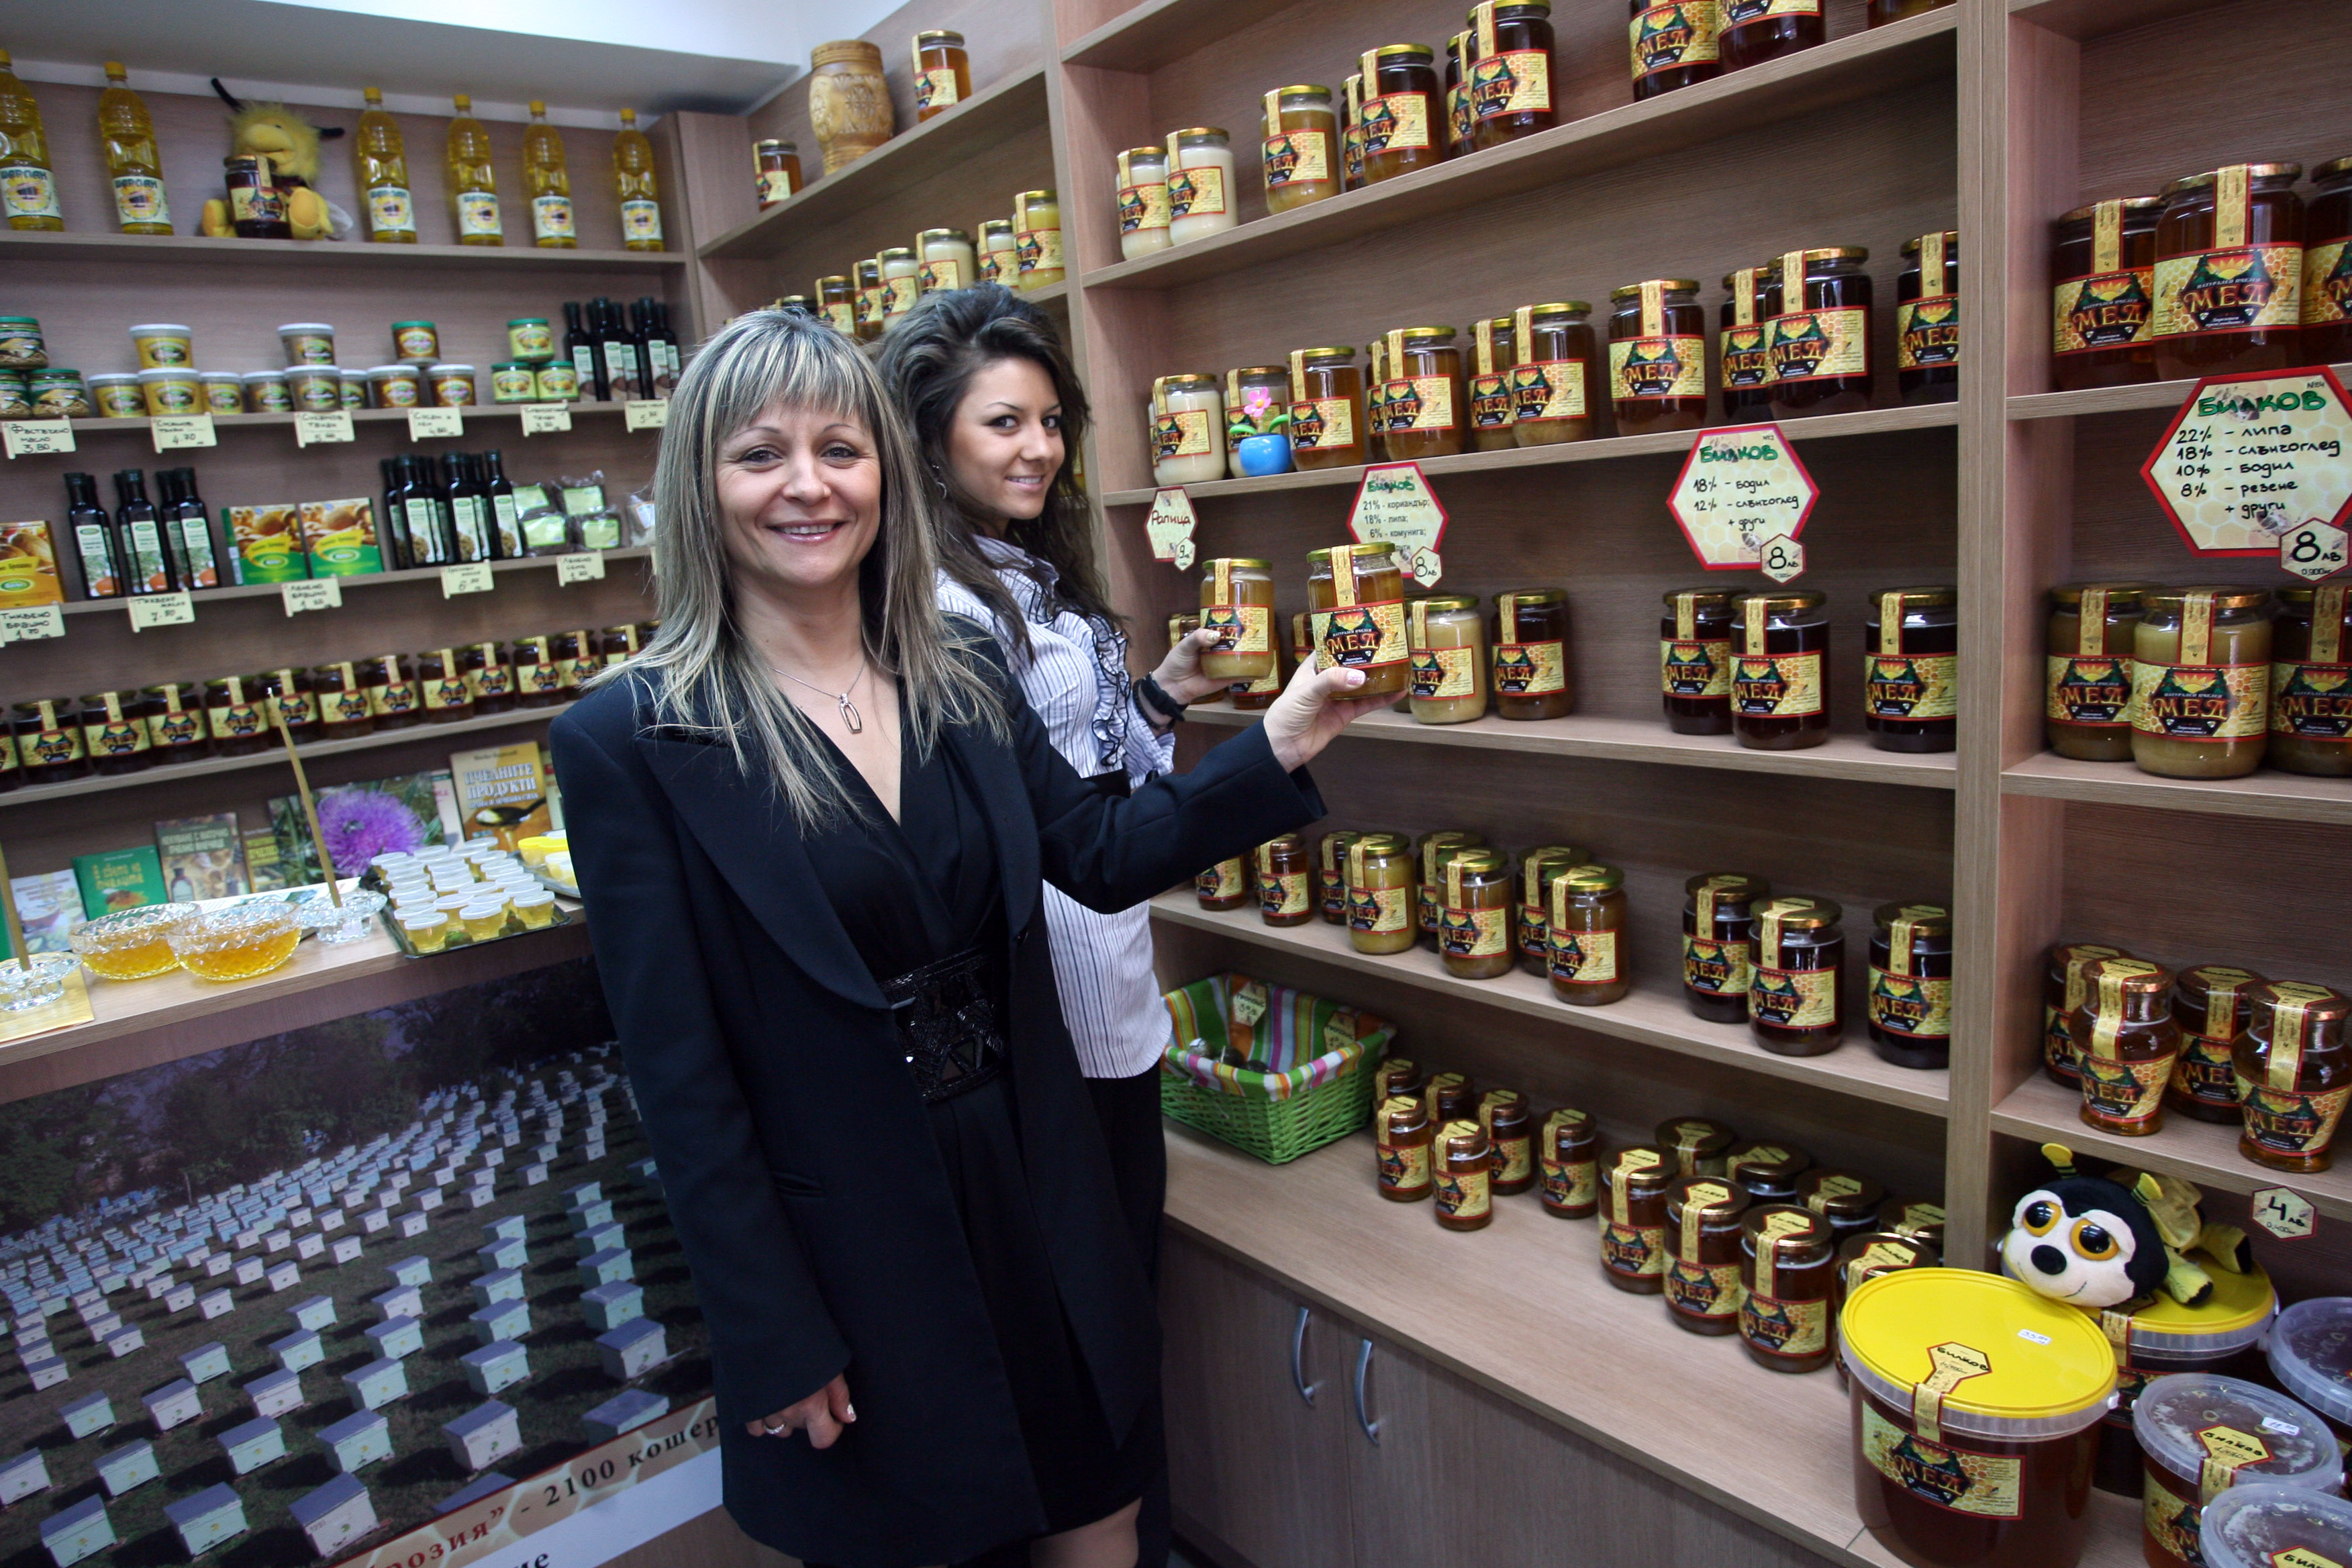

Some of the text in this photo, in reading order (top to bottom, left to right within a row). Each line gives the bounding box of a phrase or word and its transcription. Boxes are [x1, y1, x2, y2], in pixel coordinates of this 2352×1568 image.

[1637, 26, 1691, 59] МЕД
[2183, 283, 2267, 313] МЕД
[2072, 304, 2145, 332] МЕД
[1770, 338, 1826, 363] МЕД
[1624, 362, 1677, 383] МЕД
[2175, 426, 2212, 444] 22%
[2241, 424, 2292, 437] липа
[2176, 444, 2213, 460] 18%
[2175, 463, 2211, 478] 10%
[1693, 476, 1717, 493] 18%
[2181, 482, 2207, 497] 8%
[2241, 481, 2299, 497] резене
[1363, 500, 1381, 511] 21%
[1694, 497, 1717, 512] 12%
[2241, 502, 2286, 520] други
[1151, 509, 1191, 527] Рапица
[1364, 514, 1381, 524] 18%
[1738, 518, 1765, 532] други
[1370, 528, 1383, 538] 6%
[2291, 530, 2322, 562] 8
[1414, 556, 1428, 577] 8
[1768, 546, 1787, 570] 8
[1326, 633, 1379, 654] МЕД
[1666, 665, 1711, 683] МЕД
[1734, 681, 1783, 702] МЕД
[1869, 683, 1920, 704] МЕД
[2060, 687, 2128, 707] МЕД
[2153, 698, 2228, 721] МЕД
[1685, 959, 1727, 981] МЕД
[1751, 992, 1798, 1014] МЕД
[1874, 995, 1924, 1021] МЕД
[2244, 1105, 2316, 1137] МЕД
[2268, 1195, 2287, 1220] 4
[544, 1460, 616, 1508] 2100
[1895, 1453, 1967, 1498] МЕД
